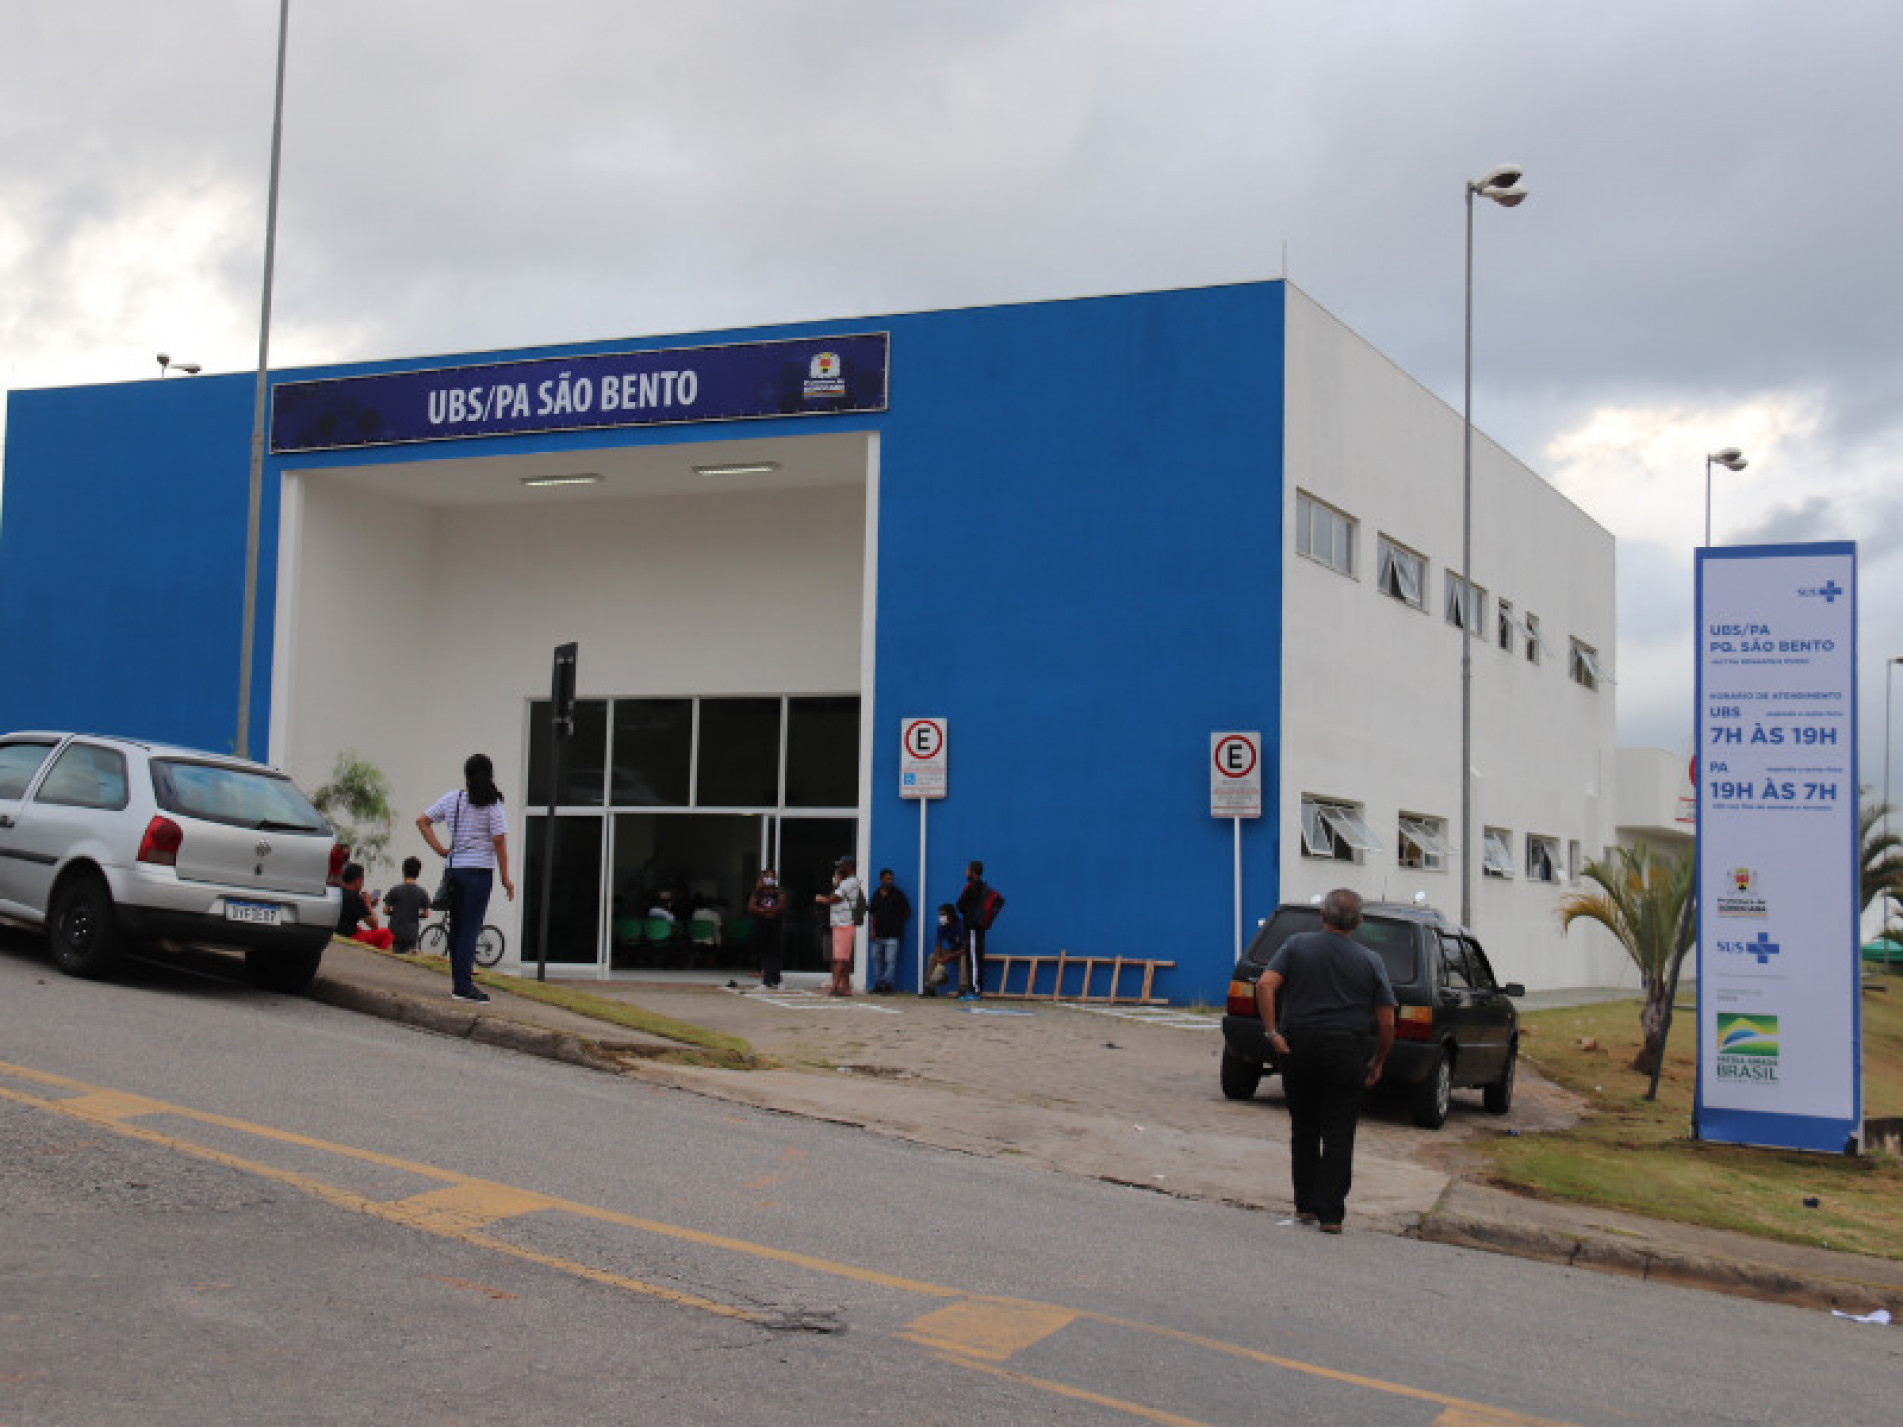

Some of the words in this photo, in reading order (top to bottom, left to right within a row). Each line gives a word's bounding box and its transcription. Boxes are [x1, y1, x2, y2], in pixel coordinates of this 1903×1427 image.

[427, 382, 531, 426] UBS/PA
[537, 371, 593, 416] SÃO
[601, 369, 698, 412] BENTO
[1709, 624, 1771, 637] UBS/PA
[1740, 637, 1775, 652] SÃO
[1779, 639, 1835, 652] BENTO
[1709, 706, 1742, 718] UBS
[916, 727, 931, 750] E
[1709, 727, 1743, 744] 7H
[1750, 722, 1785, 744] ÀS
[1791, 727, 1837, 745] 19H
[1227, 743, 1243, 769] E
[1709, 761, 1728, 773] PA
[1709, 782, 1754, 800] 19H
[1761, 777, 1797, 800] ÀS
[1803, 782, 1837, 800] 7H
[1716, 941, 1744, 952] SUS
[1717, 1063, 1779, 1081] BRASIL
